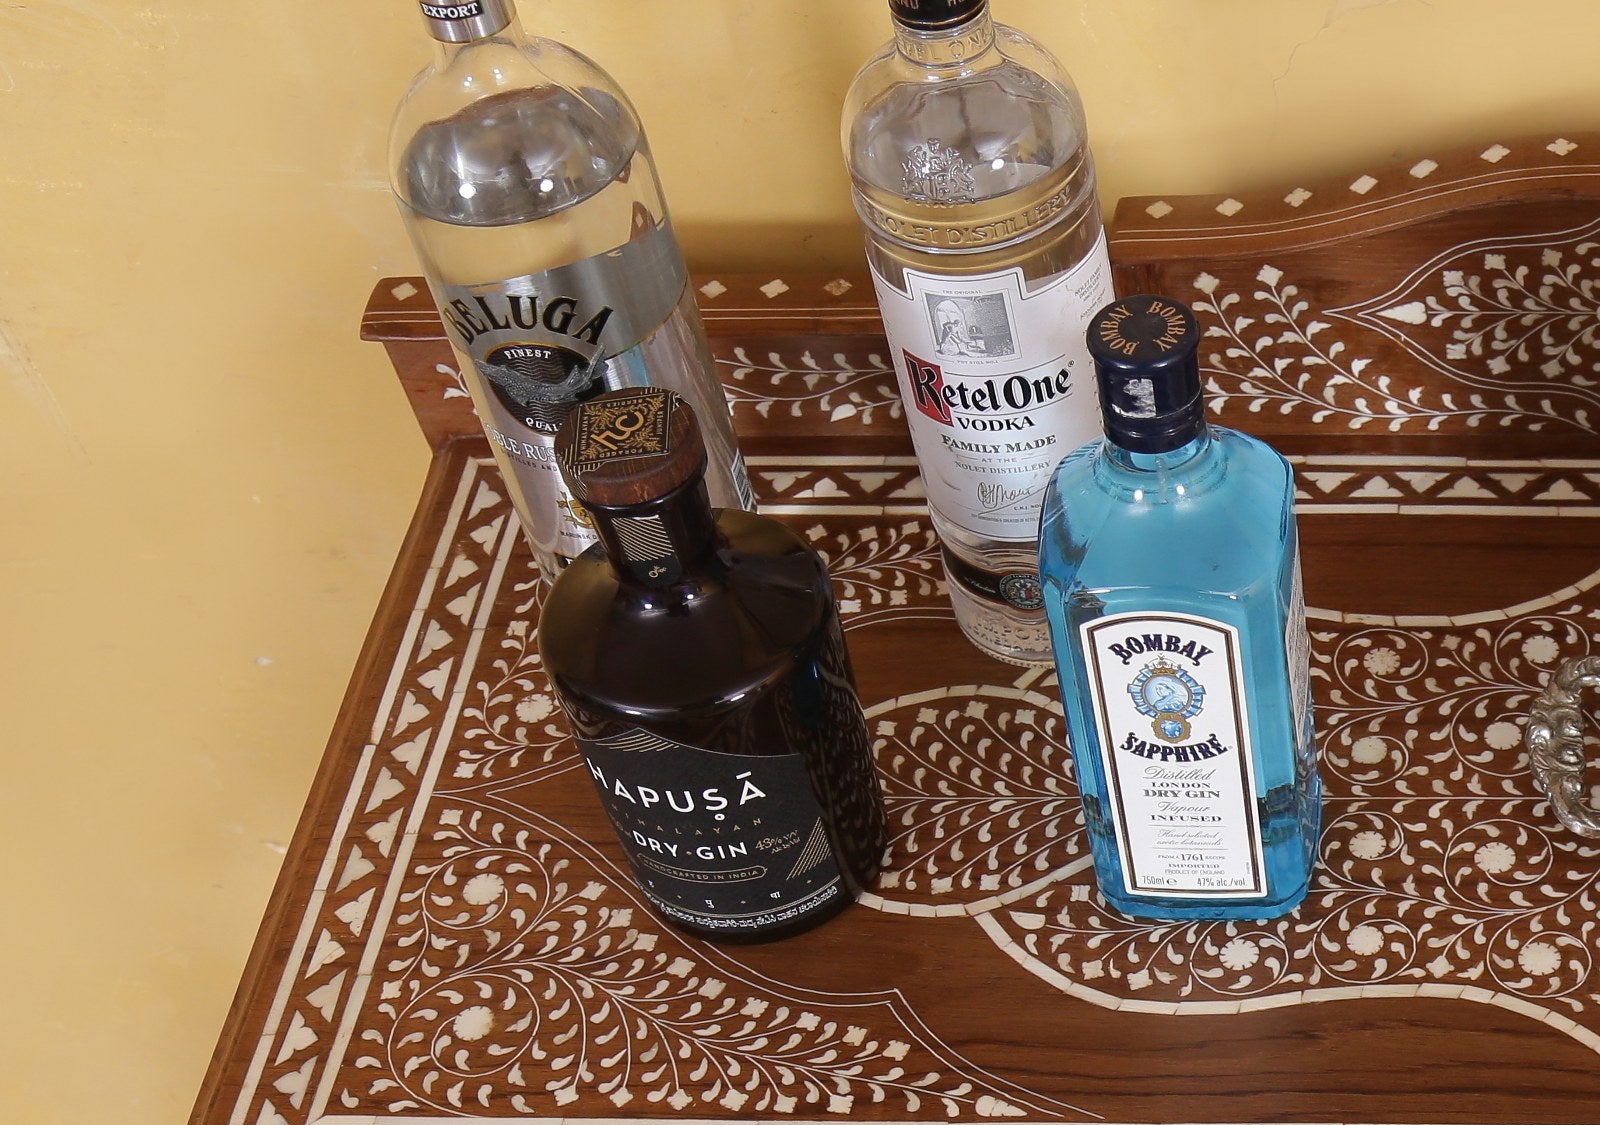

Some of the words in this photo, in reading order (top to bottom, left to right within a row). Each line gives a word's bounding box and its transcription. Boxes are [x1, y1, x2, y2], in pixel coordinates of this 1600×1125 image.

[421, 2, 479, 19] EXPORT
[444, 295, 613, 345] BELUGA
[1146, 301, 1186, 352] BOMBAY
[1101, 304, 1140, 356] BOMBAY
[504, 349, 552, 360] FINEST
[905, 354, 1001, 421] Ketel
[1003, 368, 1073, 410] One
[526, 417, 562, 432] QUAL
[956, 415, 1036, 432] VODKA
[580, 415, 589, 451] HIMALAYAN
[940, 433, 1001, 454] FAMILY
[1005, 434, 1057, 453] MADE
[599, 448, 643, 457] FORAGED
[955, 461, 988, 474] NOLET
[990, 460, 1051, 474] DISTILLERY
[1107, 633, 1215, 667] BOMBAY
[1119, 732, 1228, 762] SAPPHIRE
[1142, 765, 1217, 781] Distilled
[1143, 789, 1181, 798] DRY
[1184, 790, 1221, 798] GIN
[1157, 801, 1211, 815] Vapour
[611, 803, 762, 836] HIMALAYAN
[1157, 829, 1188, 838] Hand
[633, 830, 678, 858] DRY
[696, 841, 747, 860] GIN
[755, 836, 782, 851] 43%
[1180, 853, 1204, 861] 1761
[728, 870, 759, 879] INDIA
[1142, 876, 1165, 886] 750ml
[1197, 877, 1215, 886] 47%
